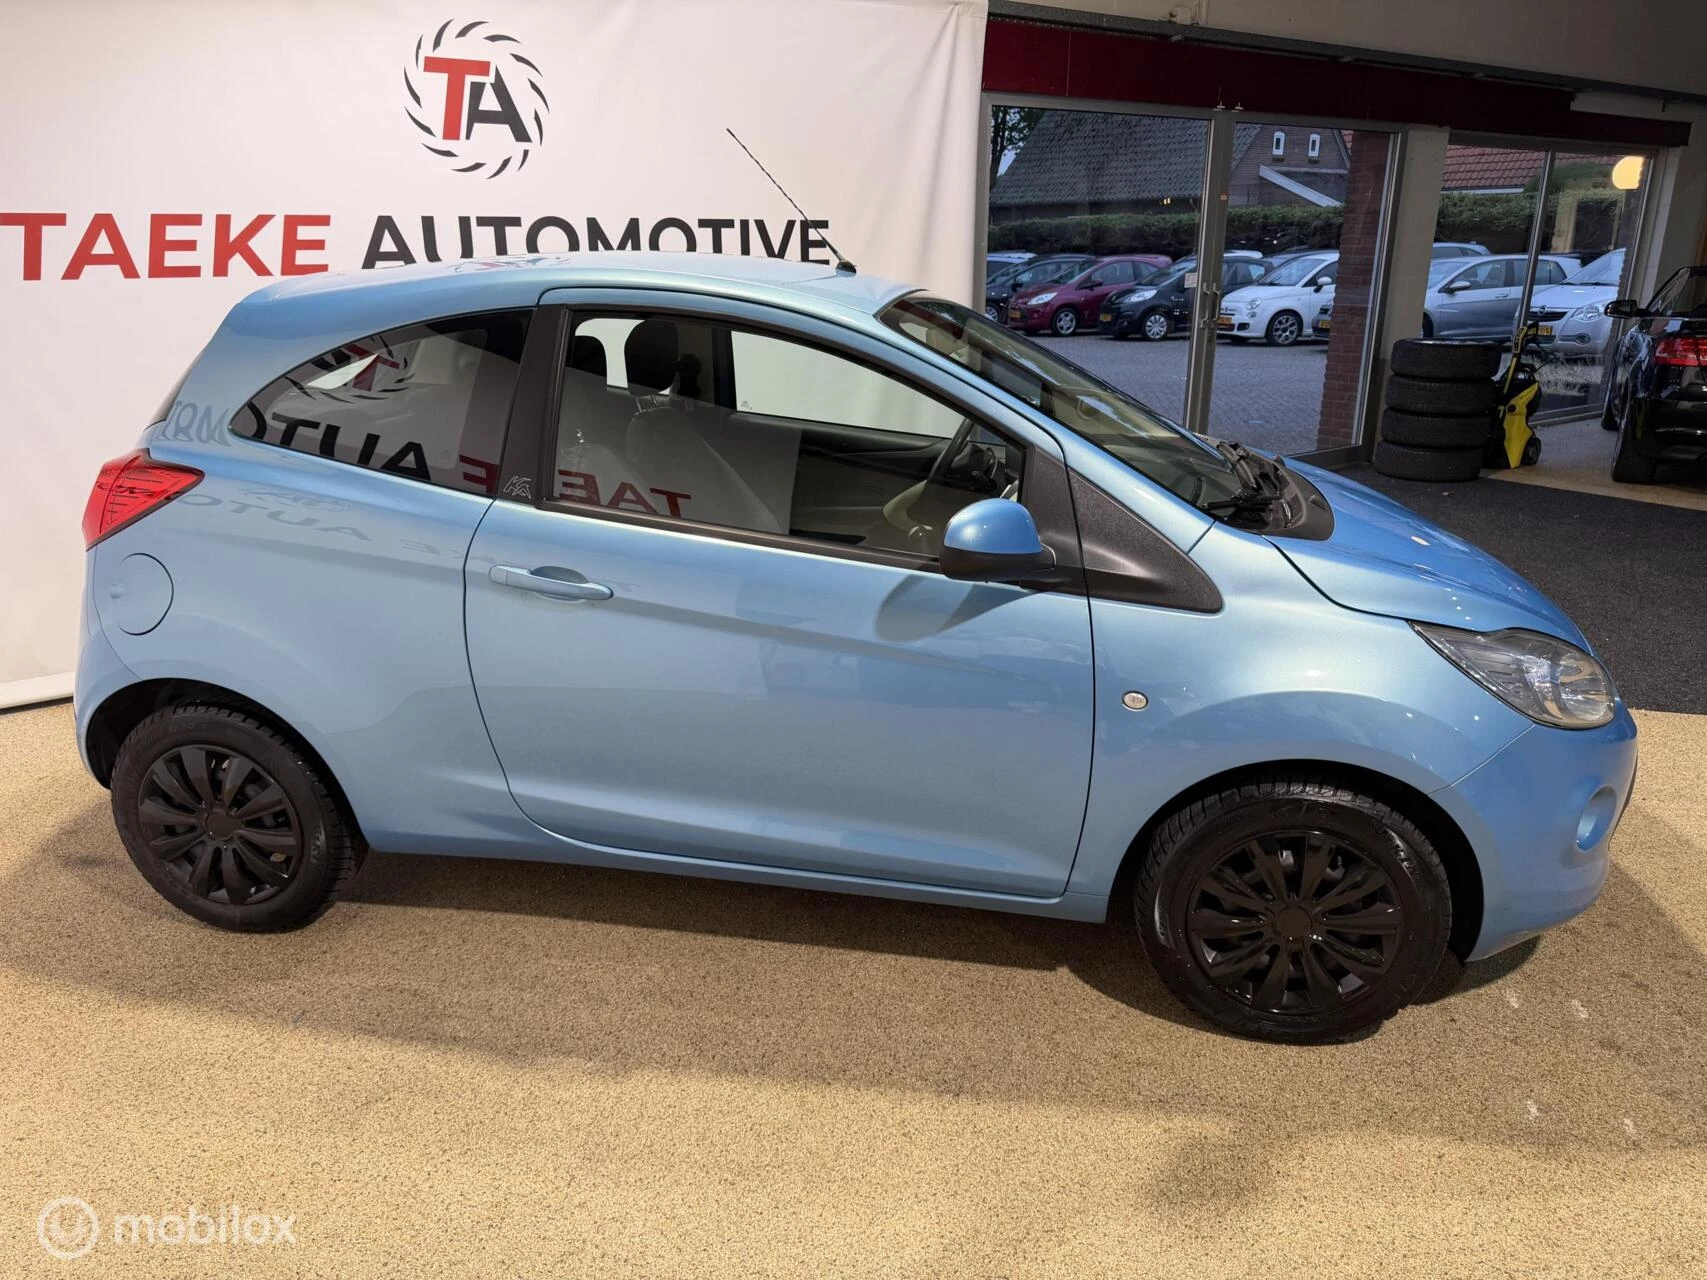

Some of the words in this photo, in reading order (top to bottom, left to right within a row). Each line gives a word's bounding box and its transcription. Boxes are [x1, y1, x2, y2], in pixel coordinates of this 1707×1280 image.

[423, 56, 533, 143] TA
[0, 213, 331, 281] TAEKE
[361, 215, 830, 269] AUTOMOTIVE
